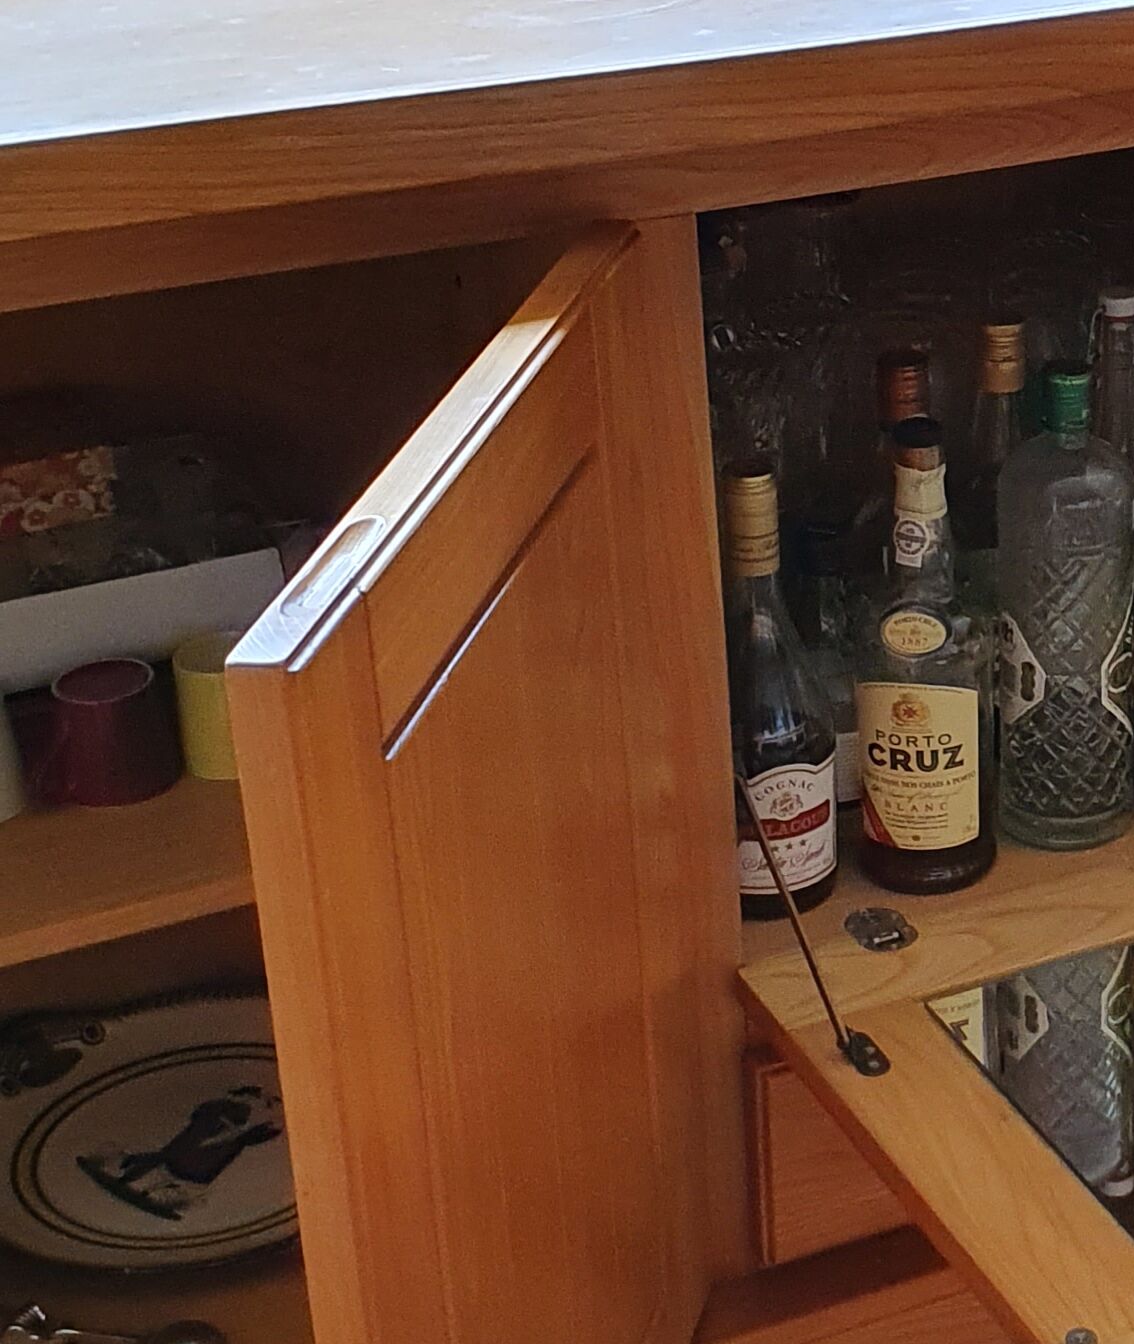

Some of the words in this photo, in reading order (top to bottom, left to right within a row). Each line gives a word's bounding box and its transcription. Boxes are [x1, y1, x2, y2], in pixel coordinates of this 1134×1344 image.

[875, 729, 952, 748] PORTO
[868, 742, 965, 773] CRUZ
[755, 778, 815, 802] COGNAC
[885, 799, 948, 813] BLANC
